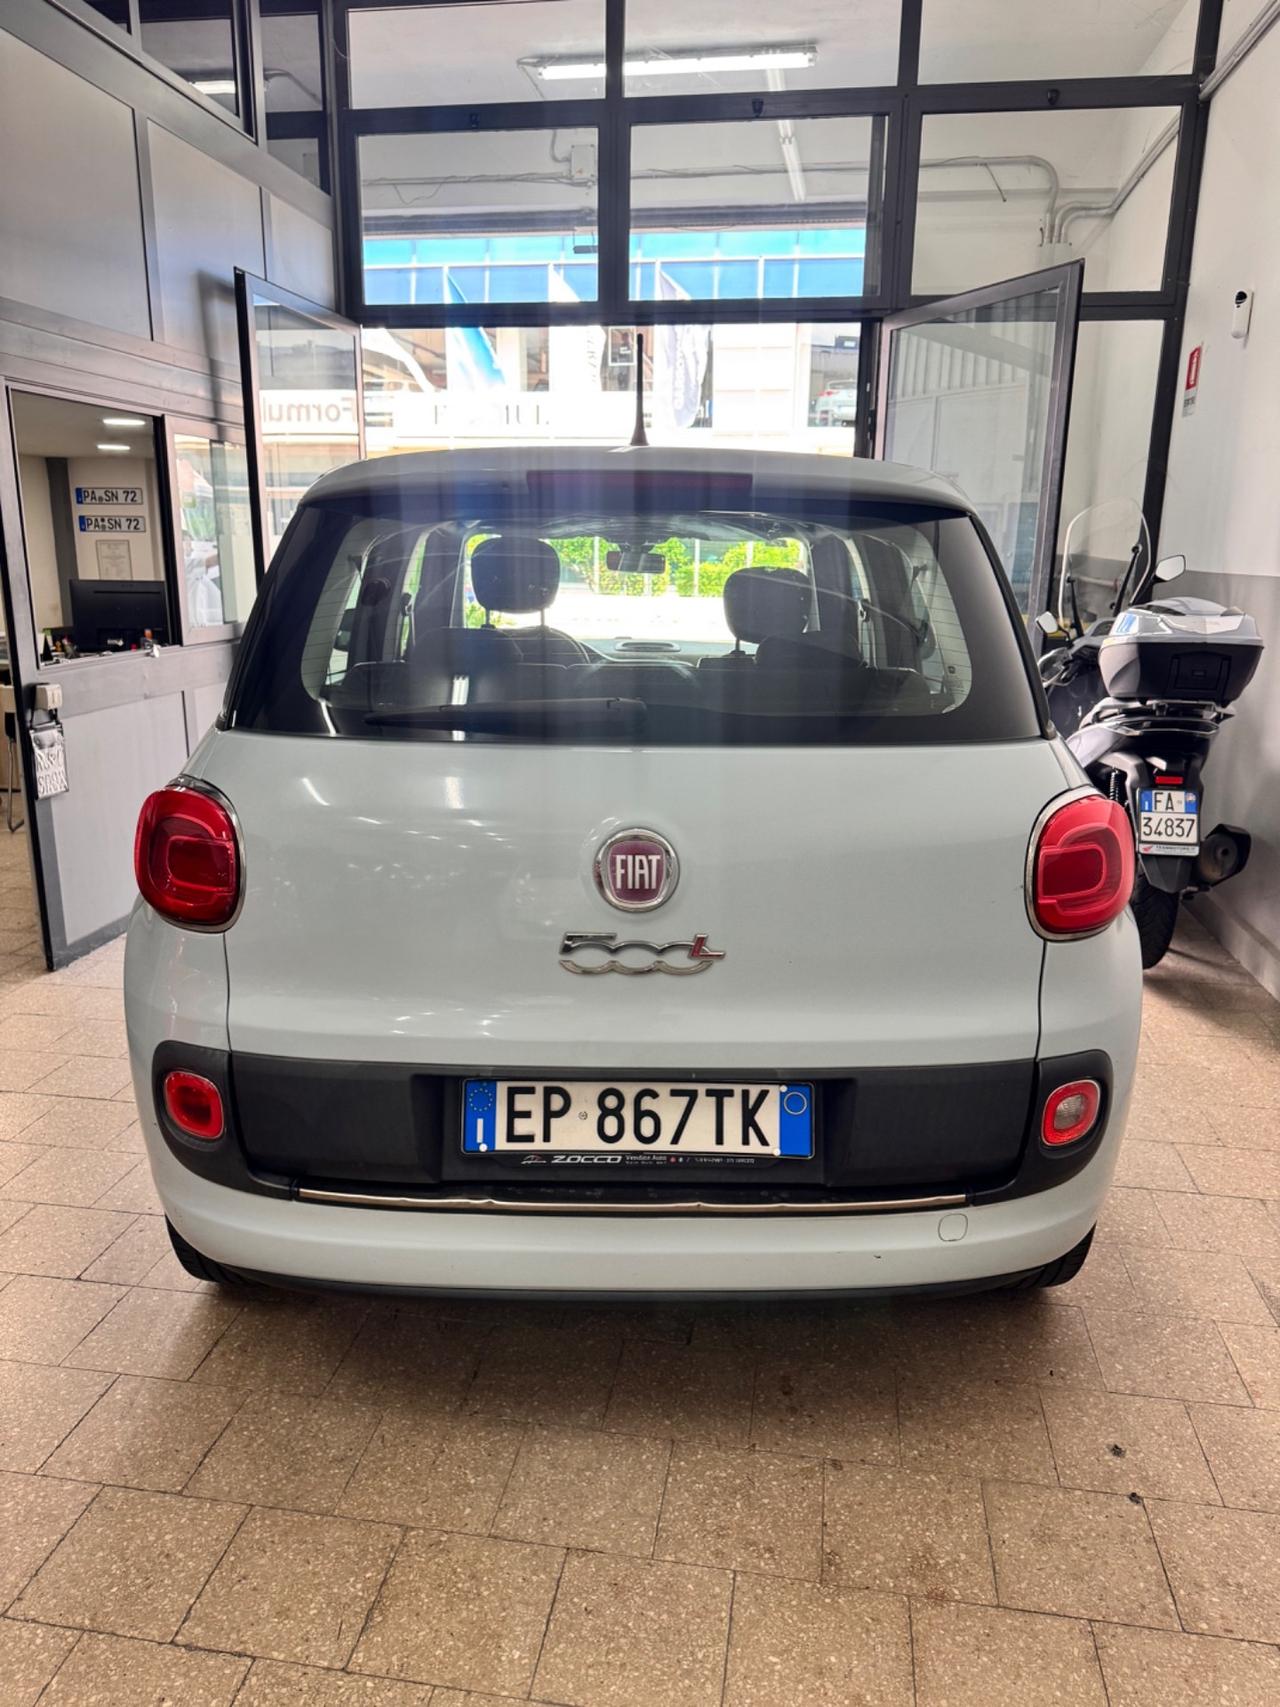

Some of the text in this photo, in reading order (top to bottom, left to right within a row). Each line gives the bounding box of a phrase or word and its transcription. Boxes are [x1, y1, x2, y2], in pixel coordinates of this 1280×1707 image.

[83, 489, 137, 503] PA SN 72
[86, 517, 141, 531] PA SN 72
[1154, 792, 1174, 811] FA
[1143, 817, 1195, 838] 34837
[615, 855, 660, 889] FIAT
[559, 932, 726, 976] 500L
[506, 1086, 571, 1143] EP
[596, 1087, 769, 1147] 867TK
[551, 1155, 622, 1164] ZOCCO
